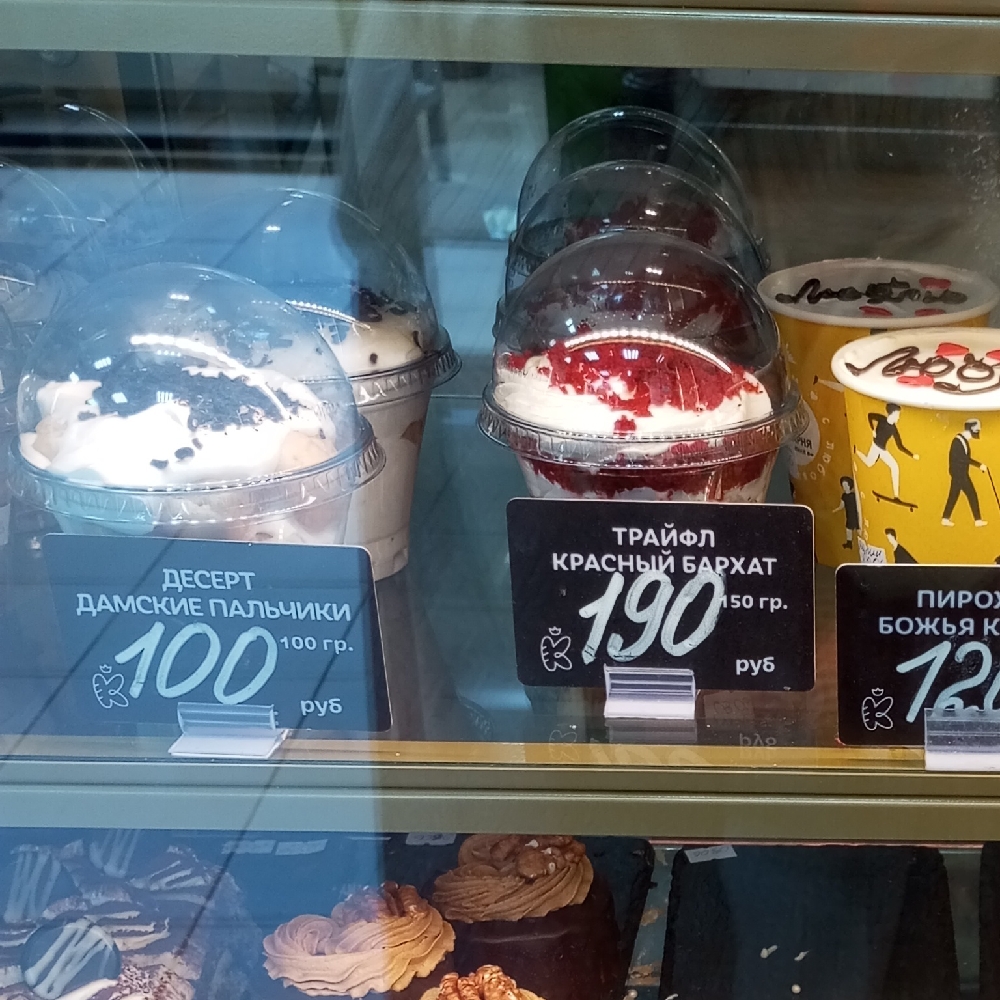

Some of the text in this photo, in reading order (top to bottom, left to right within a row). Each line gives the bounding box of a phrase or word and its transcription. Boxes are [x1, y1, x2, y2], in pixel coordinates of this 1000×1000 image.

[612, 523, 715, 548] ТРАЙФЛ
[552, 550, 777, 576] КРАСНЫЙ БАРХАТ
[162, 568, 255, 591] ДЕСЕРТ
[76, 593, 352, 621] ДАМСКИЕ ПАЛЬЧИКИ
[759, 596, 788, 613] гр.
[578, 570, 727, 665] 190
[878, 617, 974, 636] БОЖЬЯ
[280, 636, 354, 653] 100 гр.
[115, 621, 279, 705] 100
[736, 657, 776, 676] руб
[301, 698, 343, 716] руб
